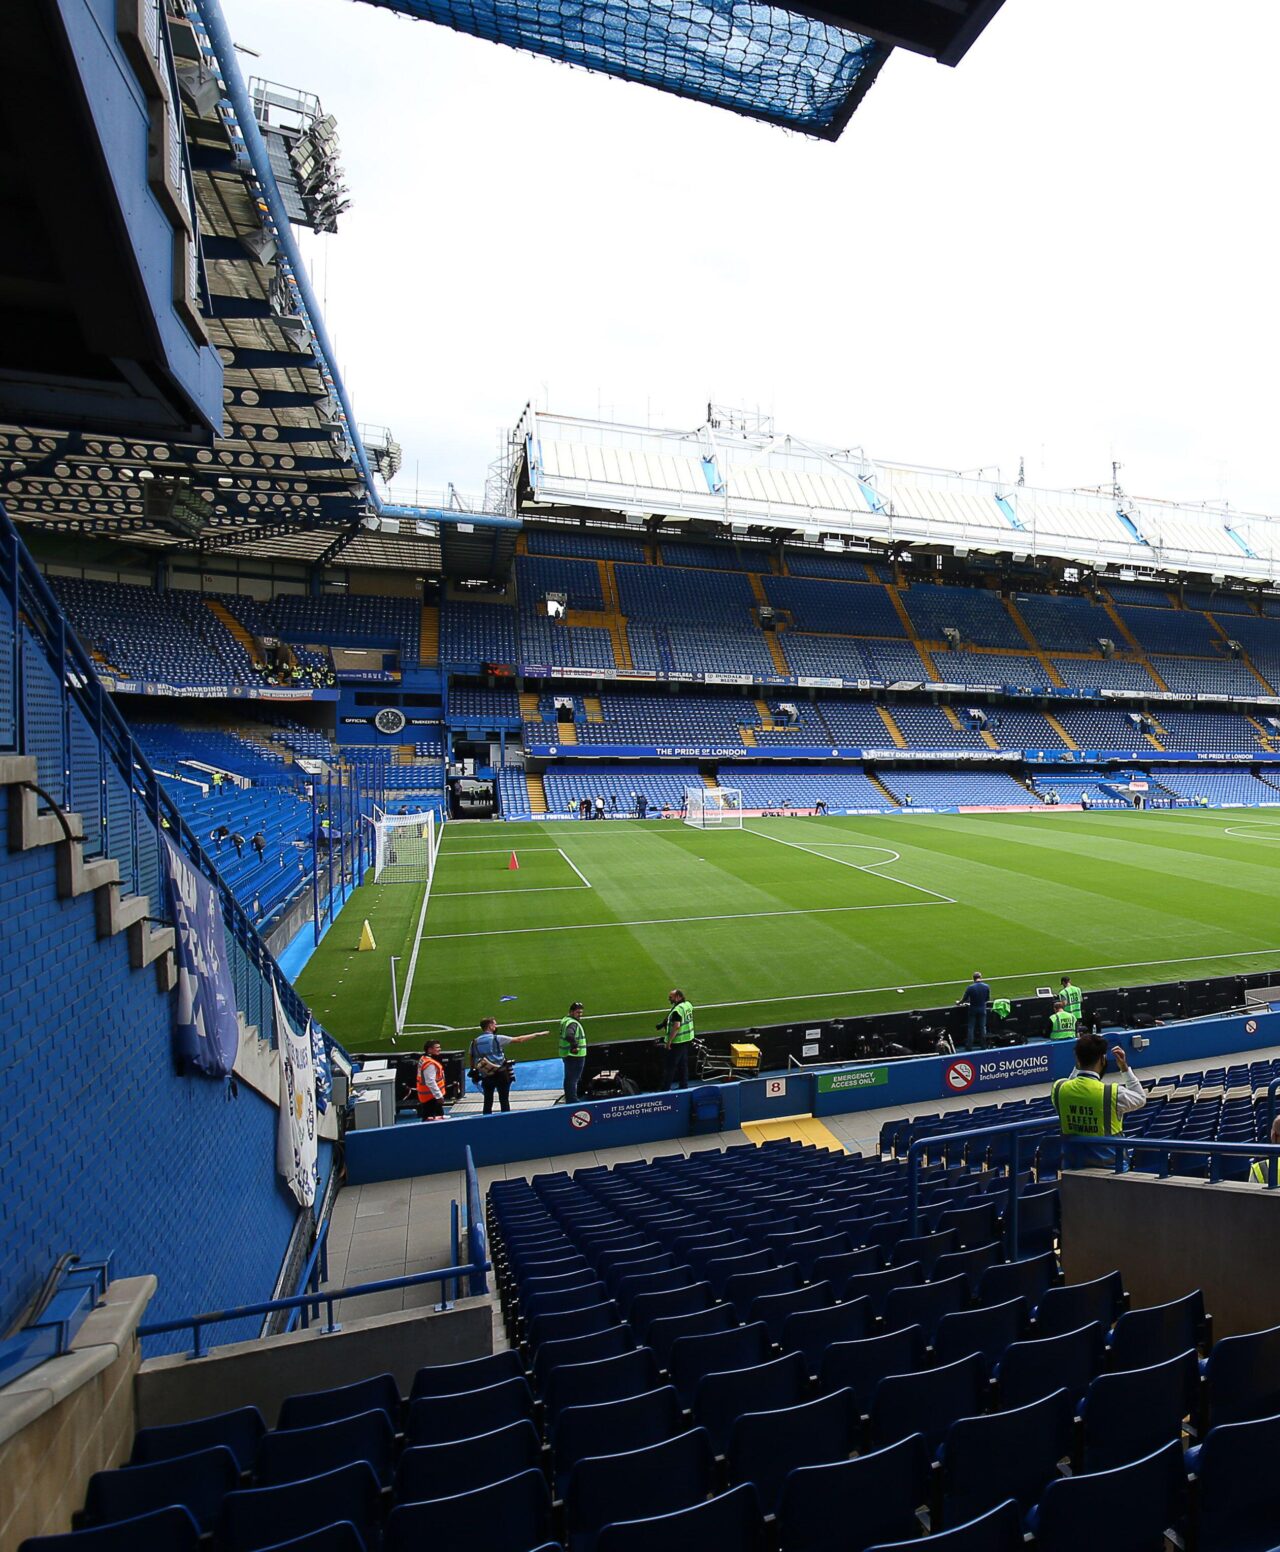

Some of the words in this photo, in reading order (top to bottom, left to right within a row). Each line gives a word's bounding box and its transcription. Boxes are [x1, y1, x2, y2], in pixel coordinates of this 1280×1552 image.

[701, 748, 710, 756] OF
[711, 748, 747, 756] LONDON
[980, 1063, 997, 1074] NO
[999, 1055, 1048, 1071] SMOKING
[833, 1071, 875, 1082] EMERGENCY
[979, 1070, 1009, 1081] Including
[1009, 1066, 1049, 1077] e-Cigarettes
[771, 1082, 781, 1093] 8
[830, 1079, 858, 1089] ACCESS
[858, 1077, 876, 1085] ONLY
[635, 1100, 663, 1109] OFFENCE
[1069, 1104, 1077, 1114] W
[1066, 1114, 1098, 1125] SAFETY
